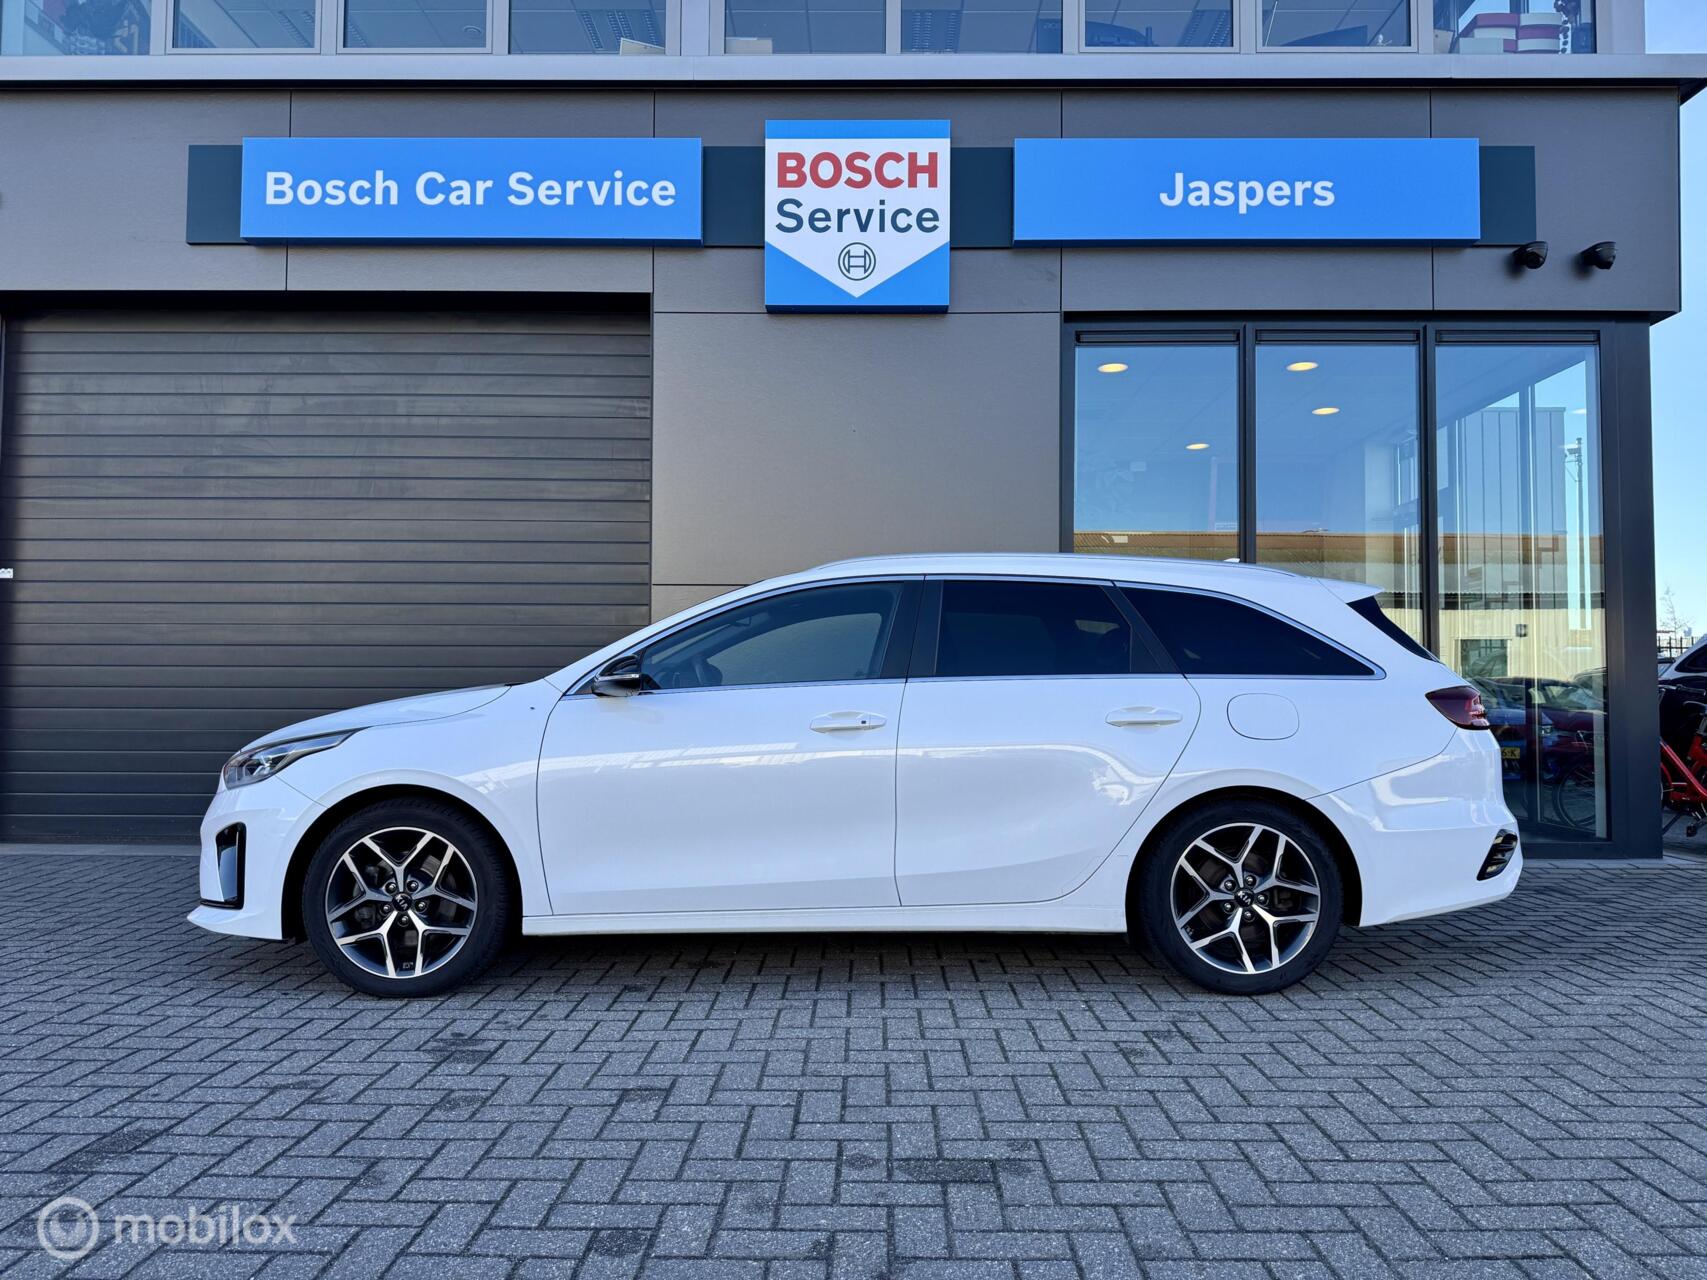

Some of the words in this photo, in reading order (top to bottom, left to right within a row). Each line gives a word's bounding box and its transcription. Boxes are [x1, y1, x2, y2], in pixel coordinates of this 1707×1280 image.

[265, 169, 398, 206] Bosch
[415, 171, 494, 206] Car
[507, 169, 676, 207] Service
[777, 151, 938, 189] BOSCH
[1159, 172, 1335, 215] Jaspers
[775, 198, 940, 234] Service
